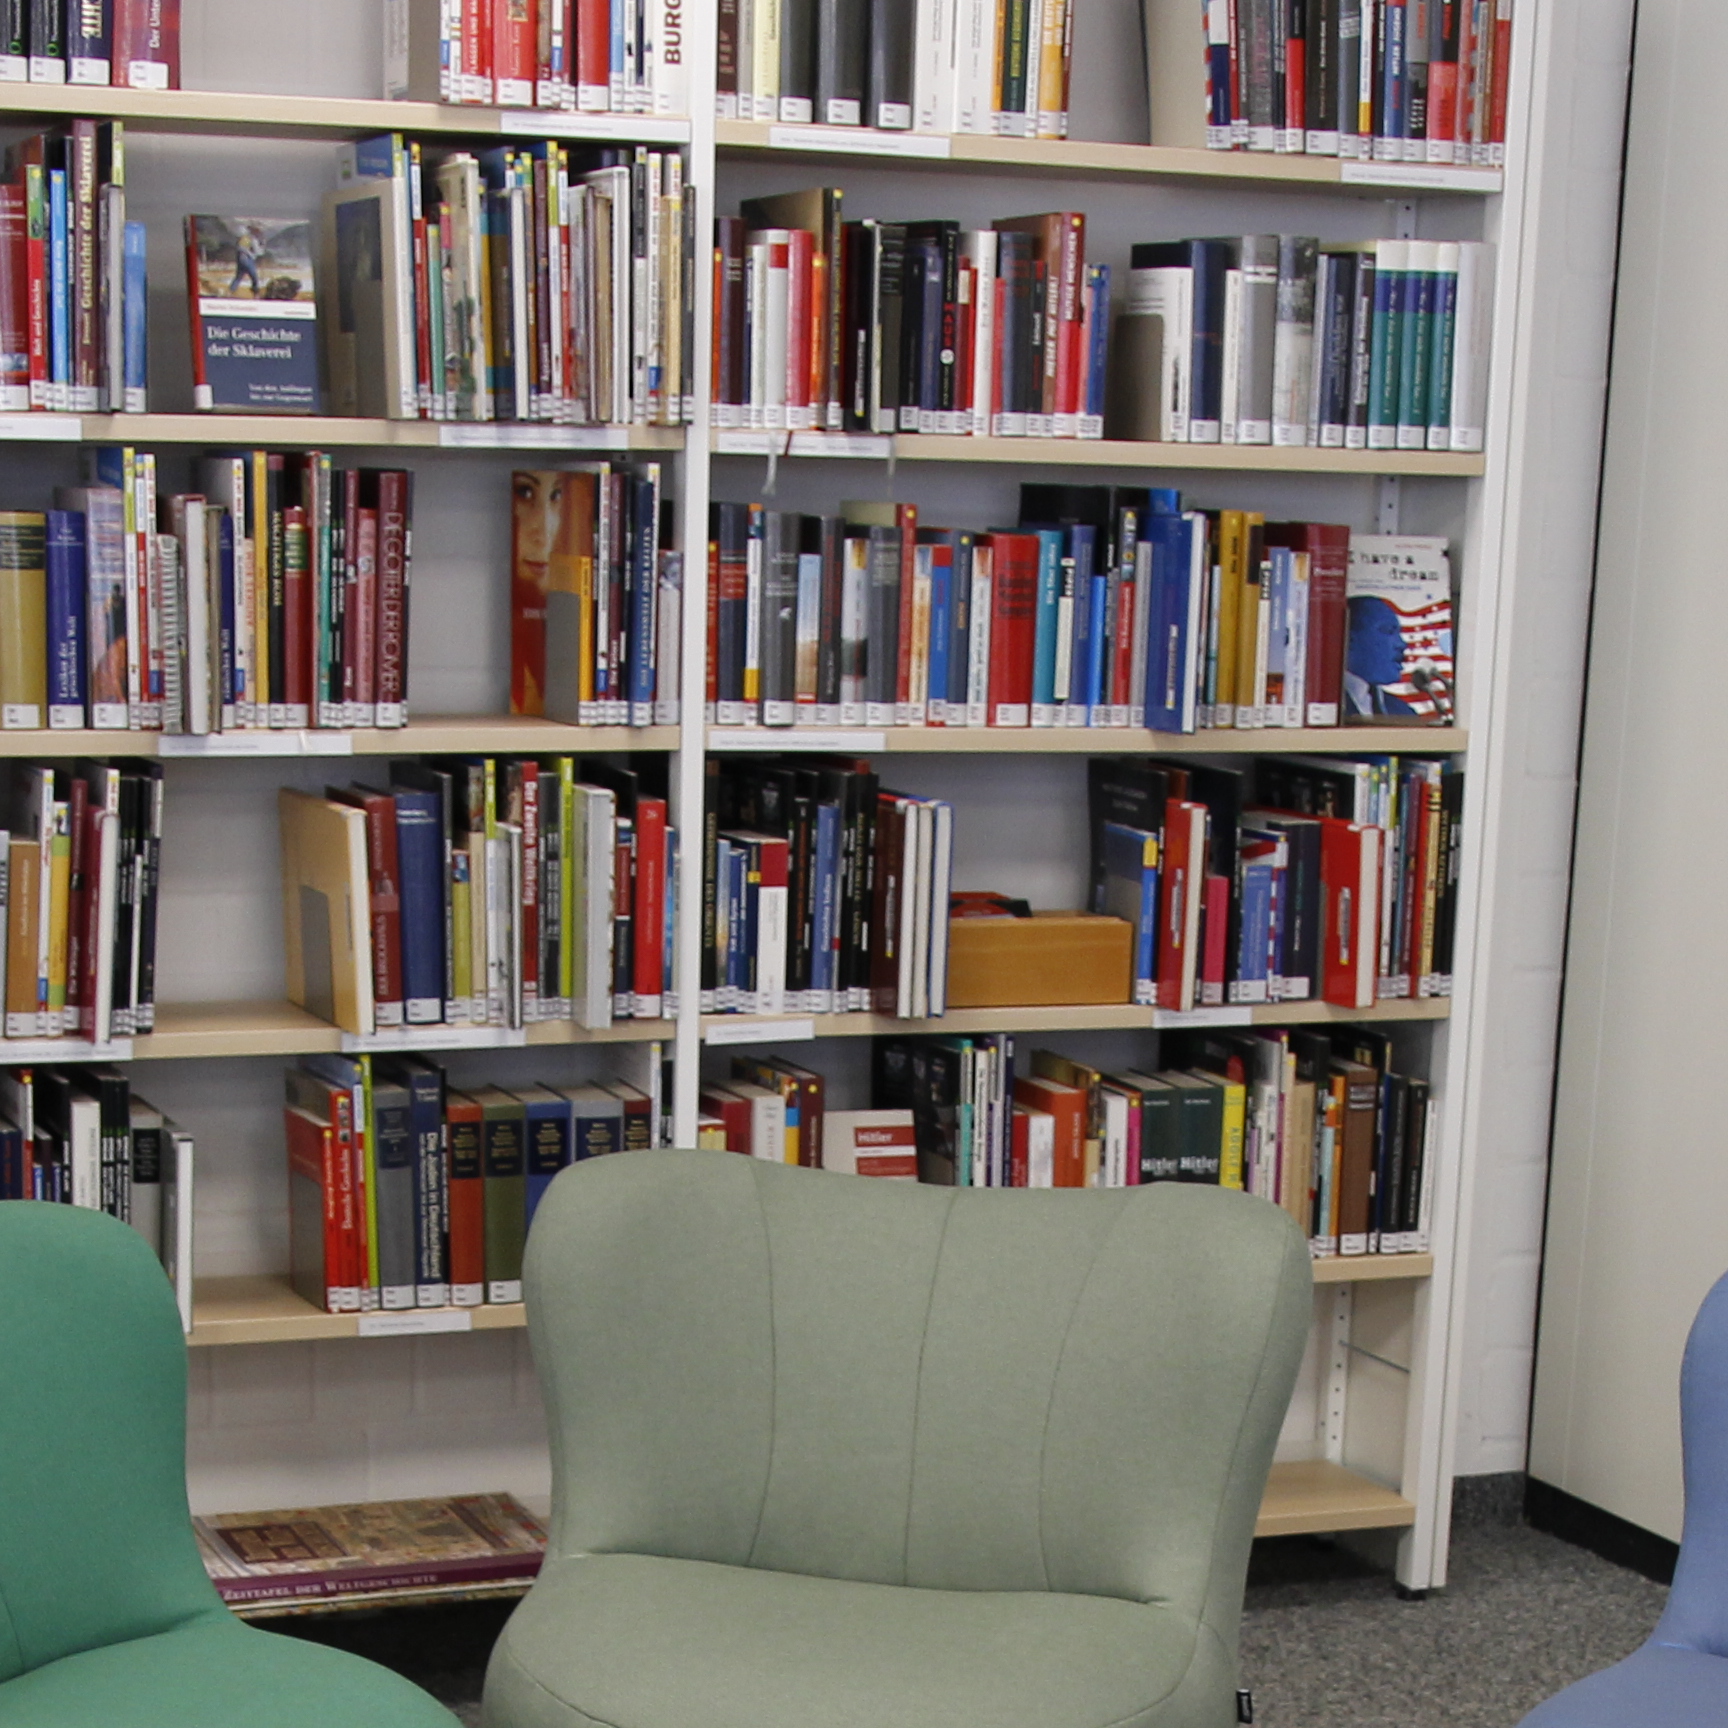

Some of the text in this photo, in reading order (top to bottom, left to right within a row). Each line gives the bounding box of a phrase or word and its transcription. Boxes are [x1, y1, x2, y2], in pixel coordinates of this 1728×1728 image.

[78, 136, 93, 310] Geschichte der Sklaverei
[206, 325, 301, 344] Die Geschichte
[207, 343, 292, 360] der Sklaverei
[1389, 569, 1440, 582] dream
[522, 781, 536, 802] Der
[522, 848, 538, 906] Weltkrieg
[426, 1131, 443, 1278] Die Juden in Deutschland
